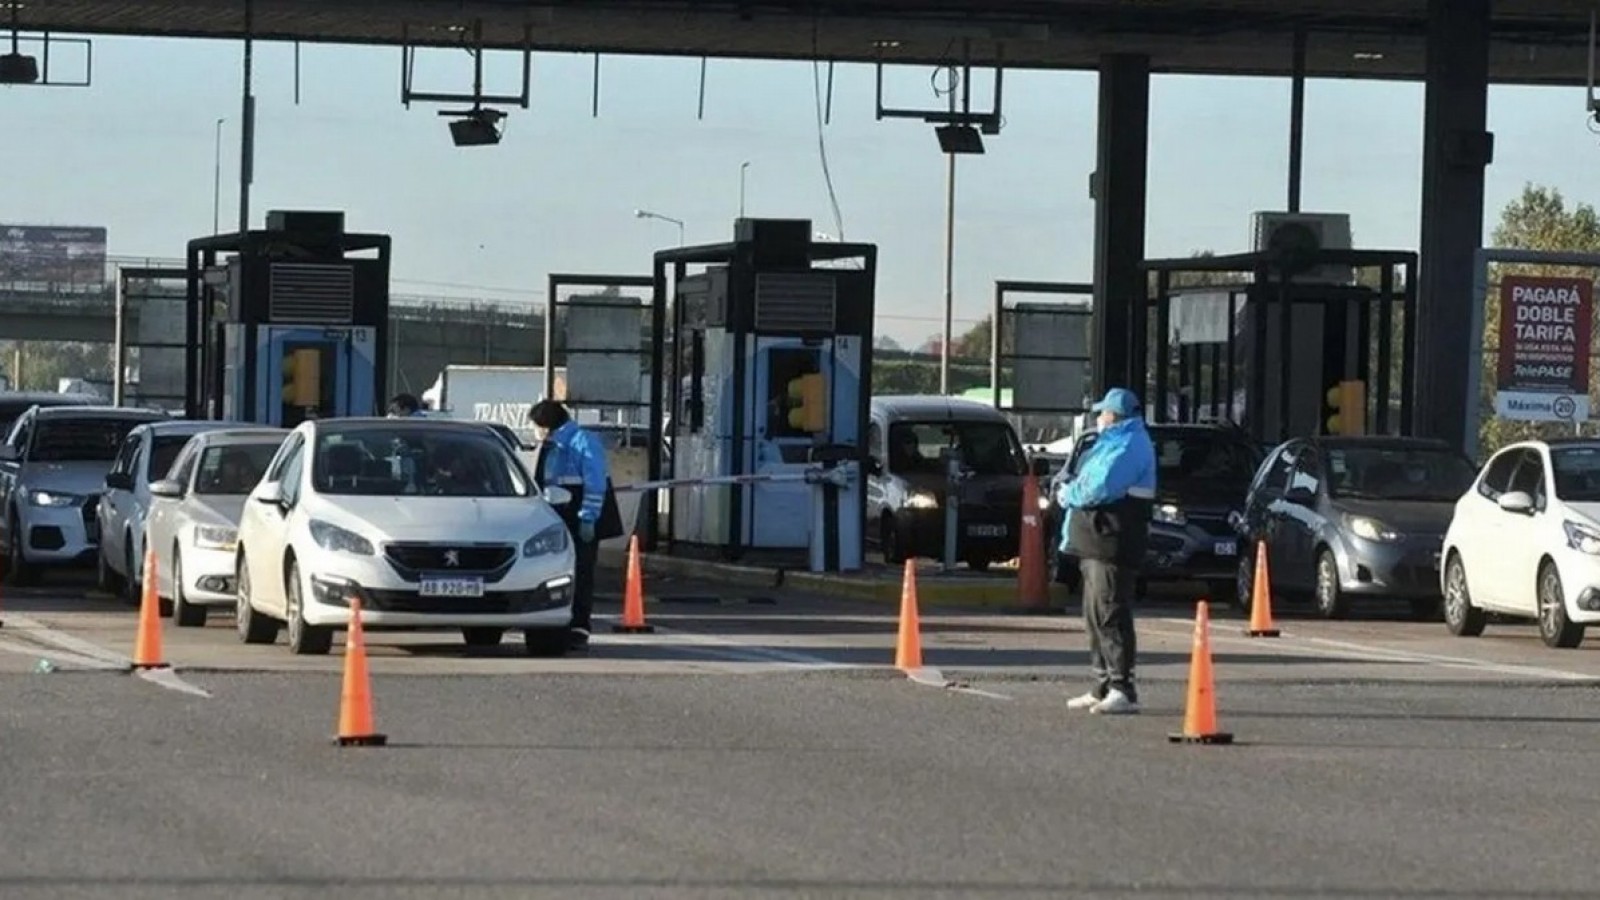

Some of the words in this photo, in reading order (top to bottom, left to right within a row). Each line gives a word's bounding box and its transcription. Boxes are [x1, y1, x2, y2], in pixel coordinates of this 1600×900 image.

[1512, 285, 1581, 304] PAGARÁ
[1516, 305, 1575, 323] DOBLE
[1514, 323, 1576, 342] TARIFA
[1513, 364, 1573, 378] TelePASE
[1557, 401, 1571, 413] 20
